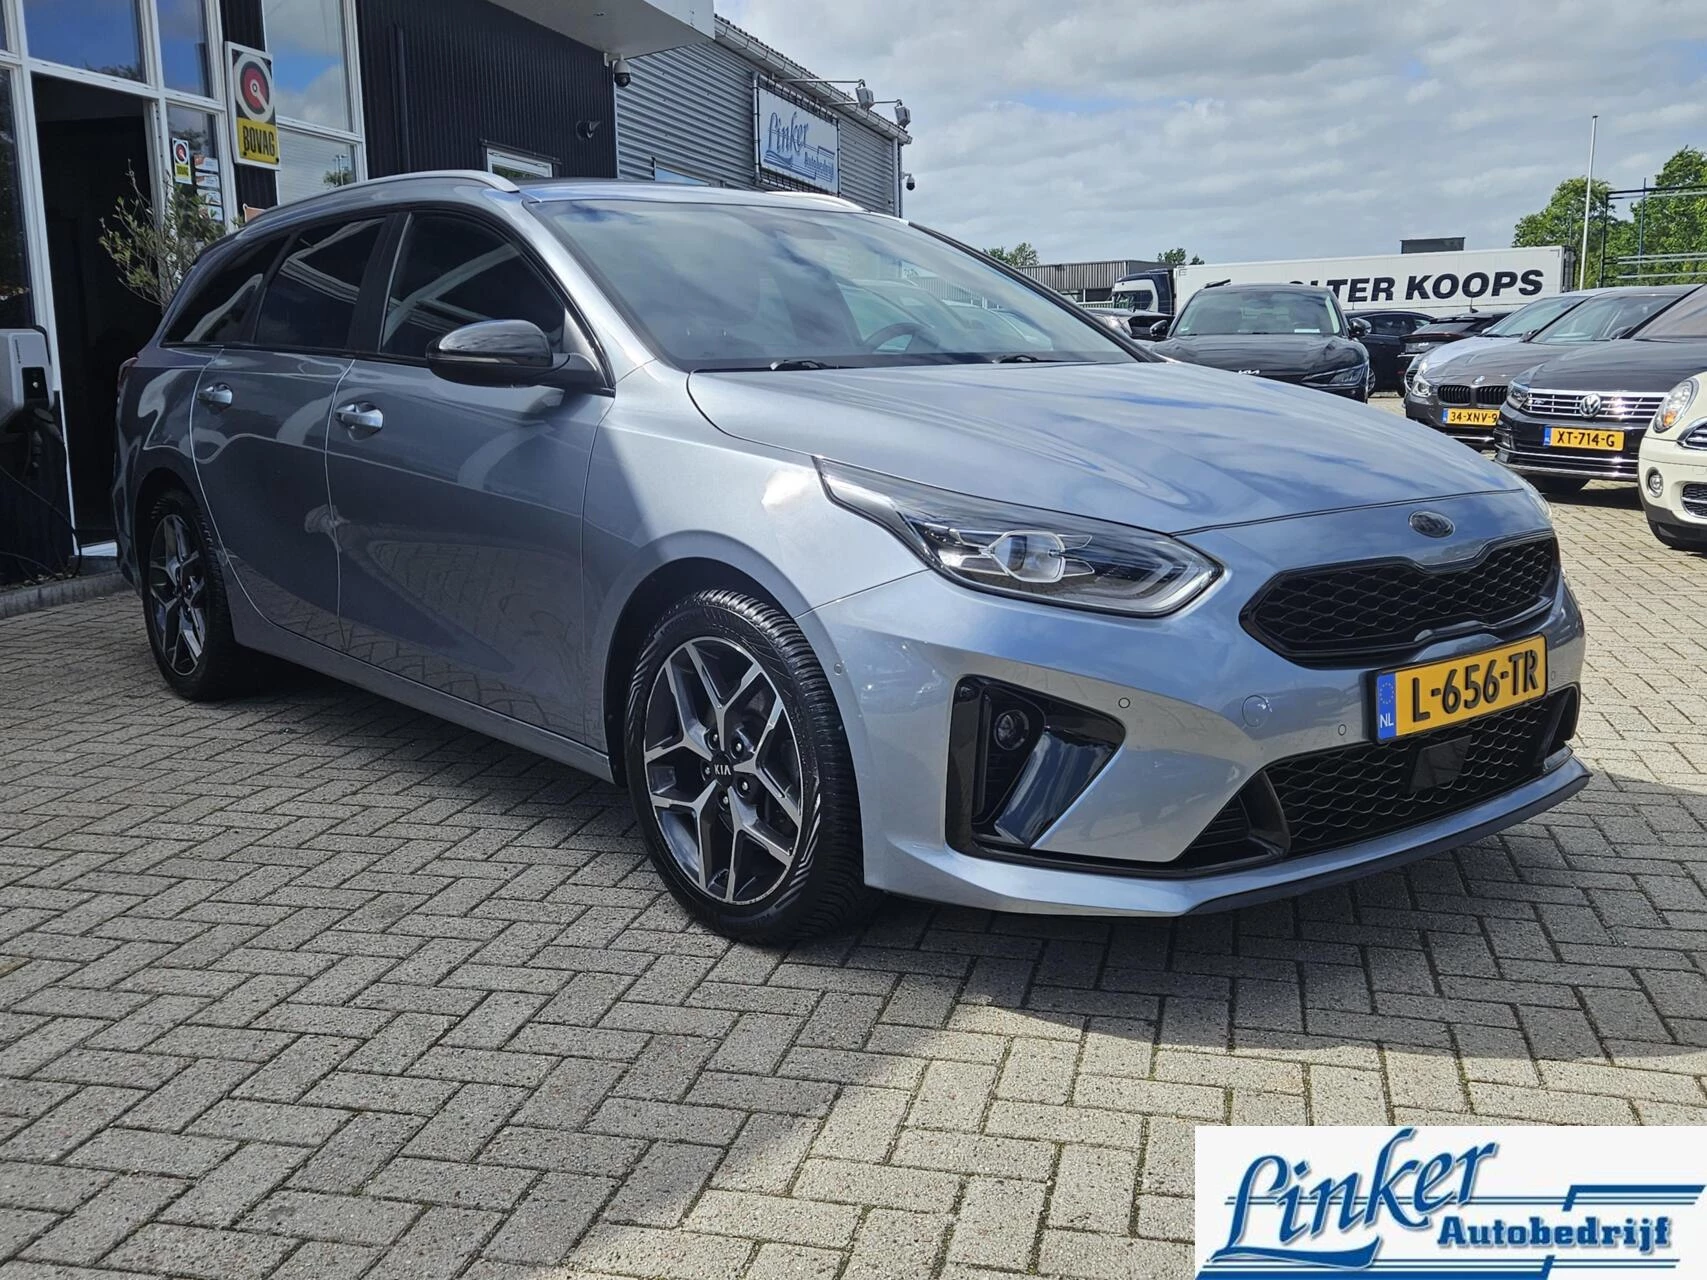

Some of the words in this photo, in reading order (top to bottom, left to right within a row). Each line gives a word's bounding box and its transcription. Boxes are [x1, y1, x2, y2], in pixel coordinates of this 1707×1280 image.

[242, 125, 276, 157] BOVAG
[765, 111, 809, 166] Linker
[1289, 277, 1396, 303] TER
[1405, 269, 1545, 301] KOOPS
[1450, 411, 1498, 424] 34-XNV-9
[1556, 430, 1615, 448] XT-714-G
[1379, 712, 1394, 729] NL
[1412, 649, 1539, 723] L-656-TR
[713, 764, 732, 776] KIA
